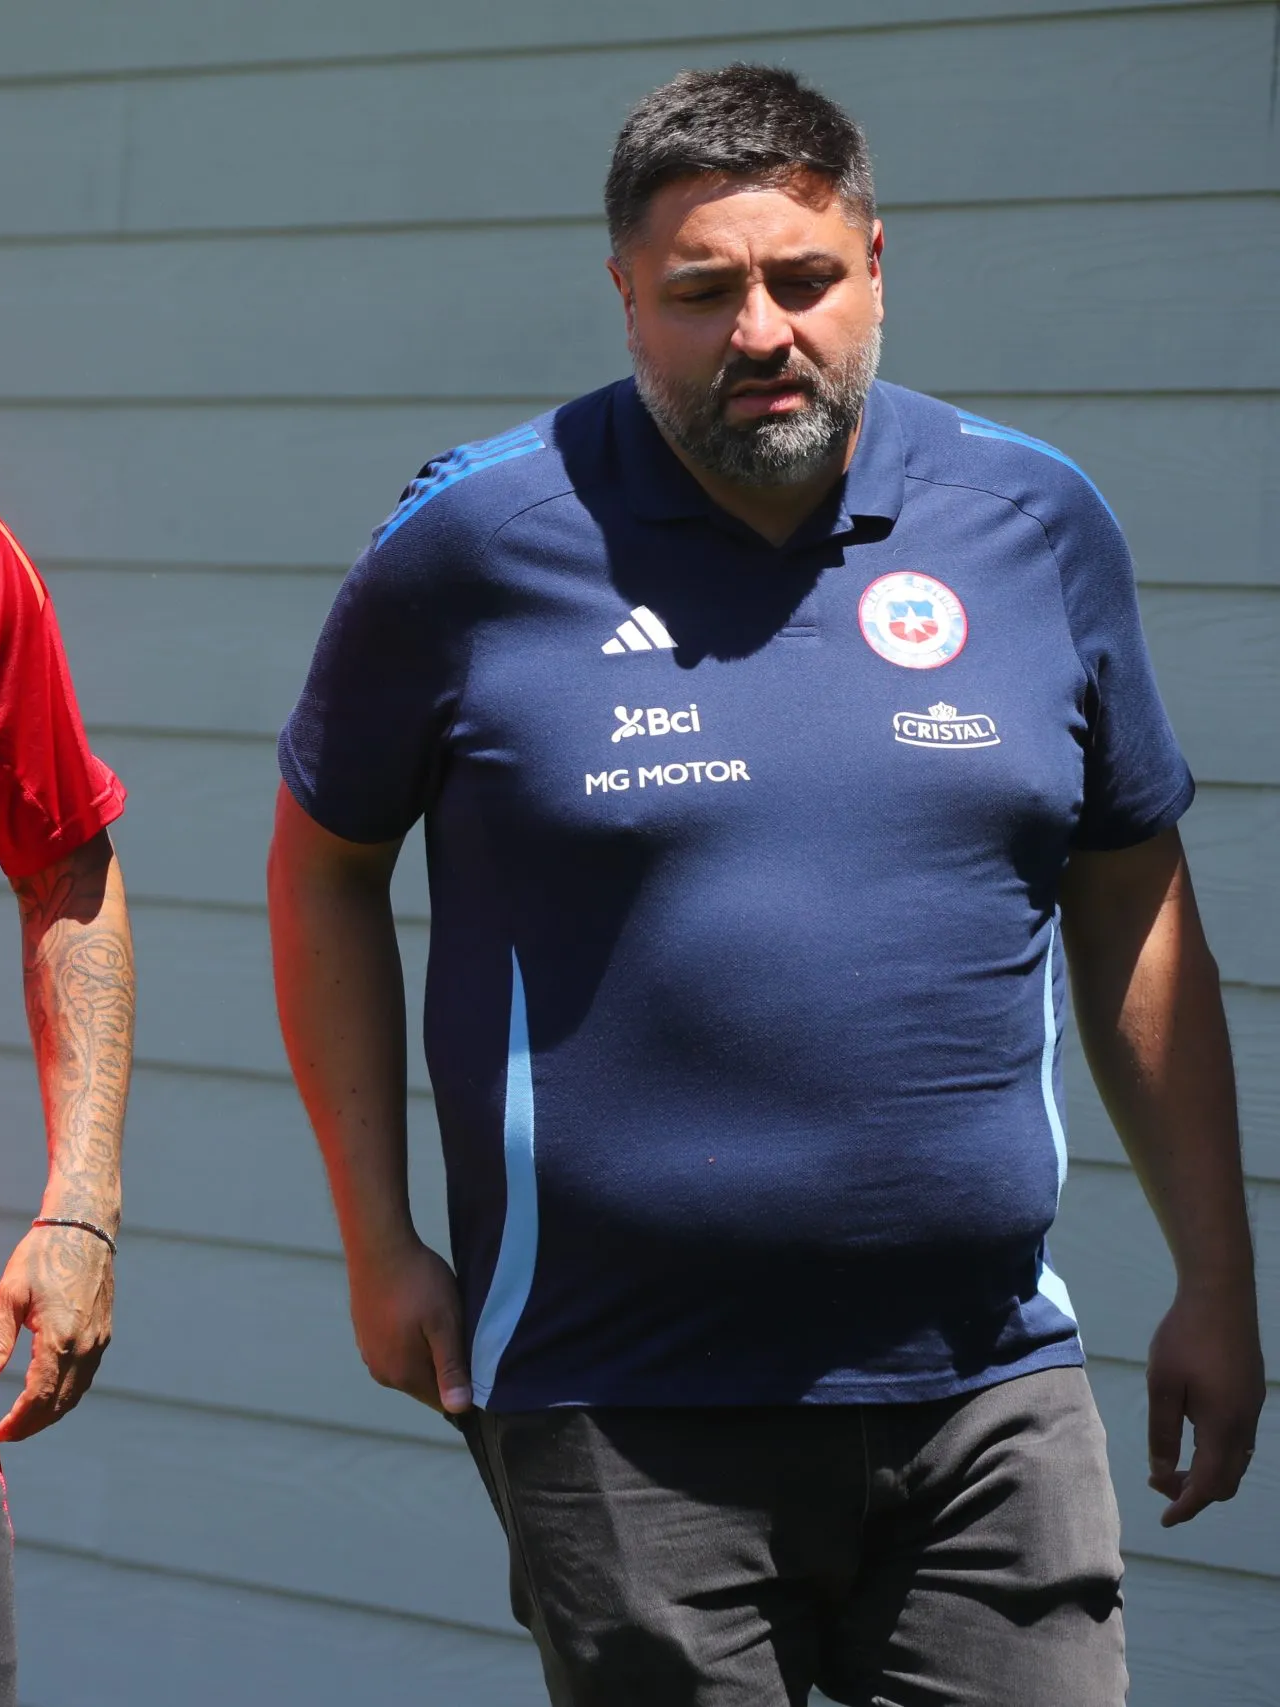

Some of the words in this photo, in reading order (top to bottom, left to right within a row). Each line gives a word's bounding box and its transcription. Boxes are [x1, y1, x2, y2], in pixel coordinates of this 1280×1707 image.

[646, 703, 701, 736] Bci
[902, 719, 990, 740] CRISTAL
[585, 769, 630, 796] MG
[638, 759, 751, 788] MOTOR
